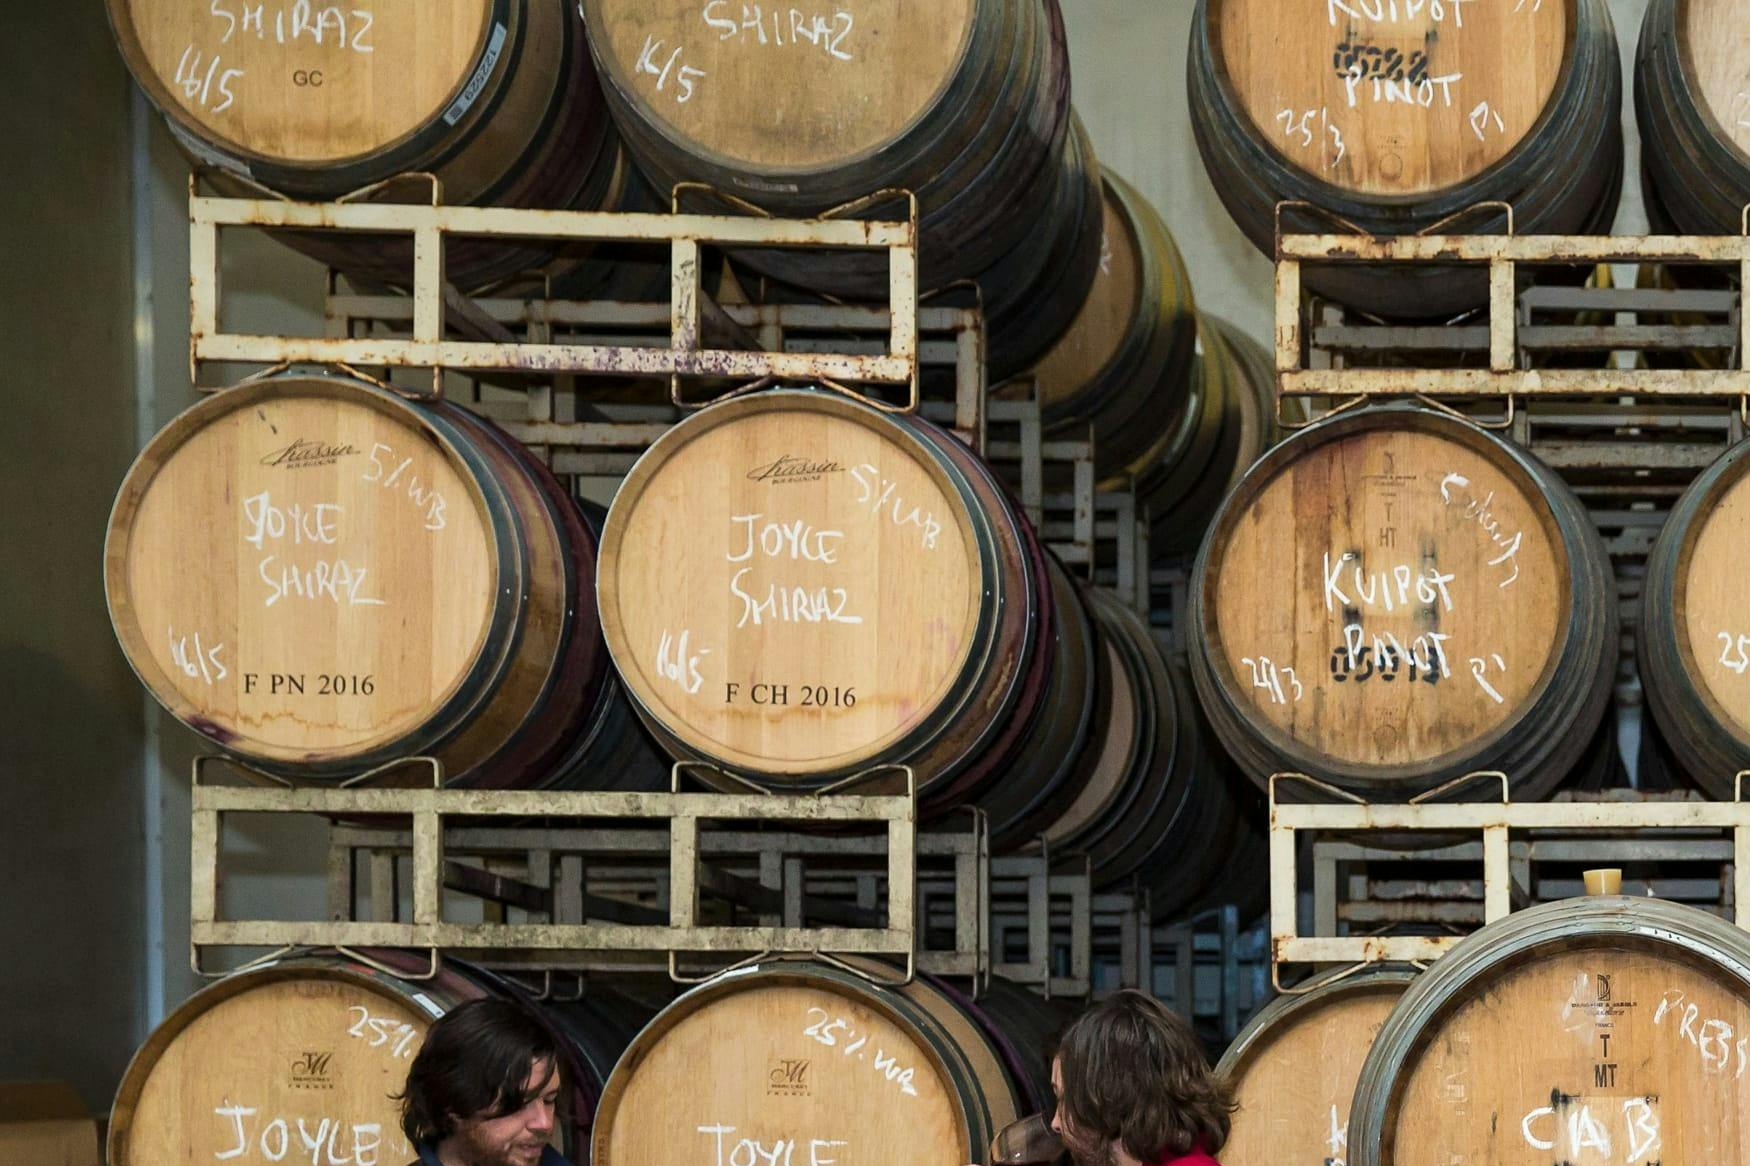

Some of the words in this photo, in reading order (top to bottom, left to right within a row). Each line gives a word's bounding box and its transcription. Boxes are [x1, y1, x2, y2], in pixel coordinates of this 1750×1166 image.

[209, 0, 375, 53] SHIRAZ
[702, 0, 854, 60] SHIRAZ
[292, 69, 324, 88] GC
[1346, 64, 1463, 108] PINOT
[244, 490, 346, 550] JOYCE
[726, 513, 846, 565] JOYCE
[258, 555, 387, 608] SHIRAZ
[730, 566, 864, 629] SHIRAZ
[1343, 623, 1453, 679] PINOT
[243, 673, 259, 694] F
[270, 673, 307, 695] PN
[318, 673, 376, 696] 2016
[725, 682, 740, 704] F
[750, 683, 789, 706] CH
[799, 685, 857, 708] 2016
[1599, 1033, 1611, 1058] T
[1594, 1063, 1618, 1088] MT
[1521, 1094, 1662, 1164] CAB
